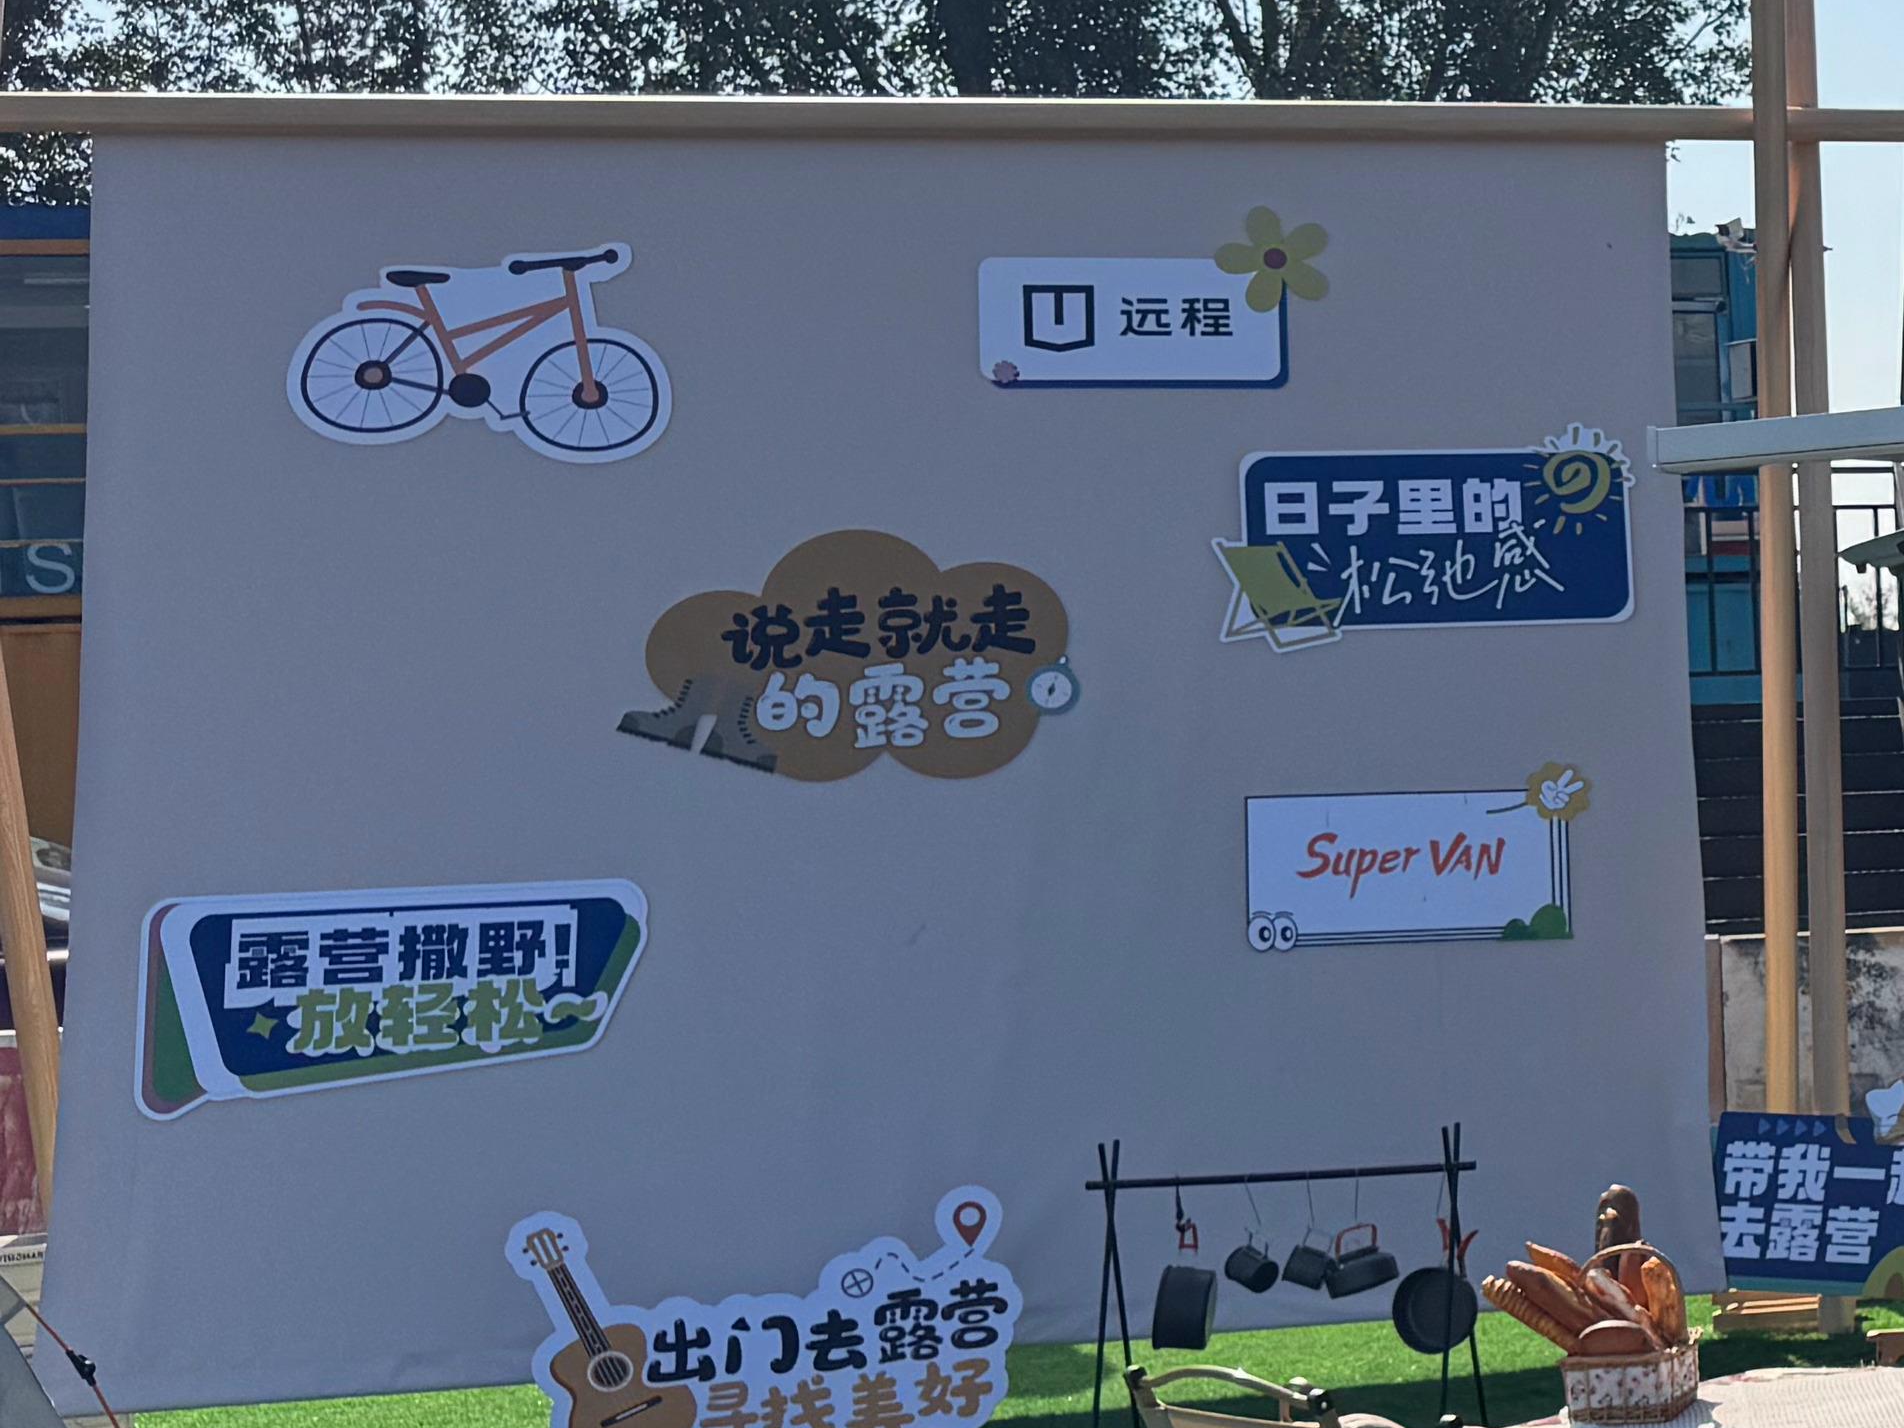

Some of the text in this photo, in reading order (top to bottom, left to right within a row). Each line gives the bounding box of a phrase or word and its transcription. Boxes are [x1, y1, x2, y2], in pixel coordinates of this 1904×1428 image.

[1120, 297, 1233, 337] 远程
[1264, 478, 1522, 536] 日子里的
[1333, 518, 1565, 627] 松弛感
[721, 584, 1036, 670] 说走就走
[756, 656, 1011, 749] 的露营
[1296, 831, 1506, 898] Super VAN
[1720, 1204, 1880, 1265] 去露营
[646, 1279, 1009, 1383] 出门去露营
